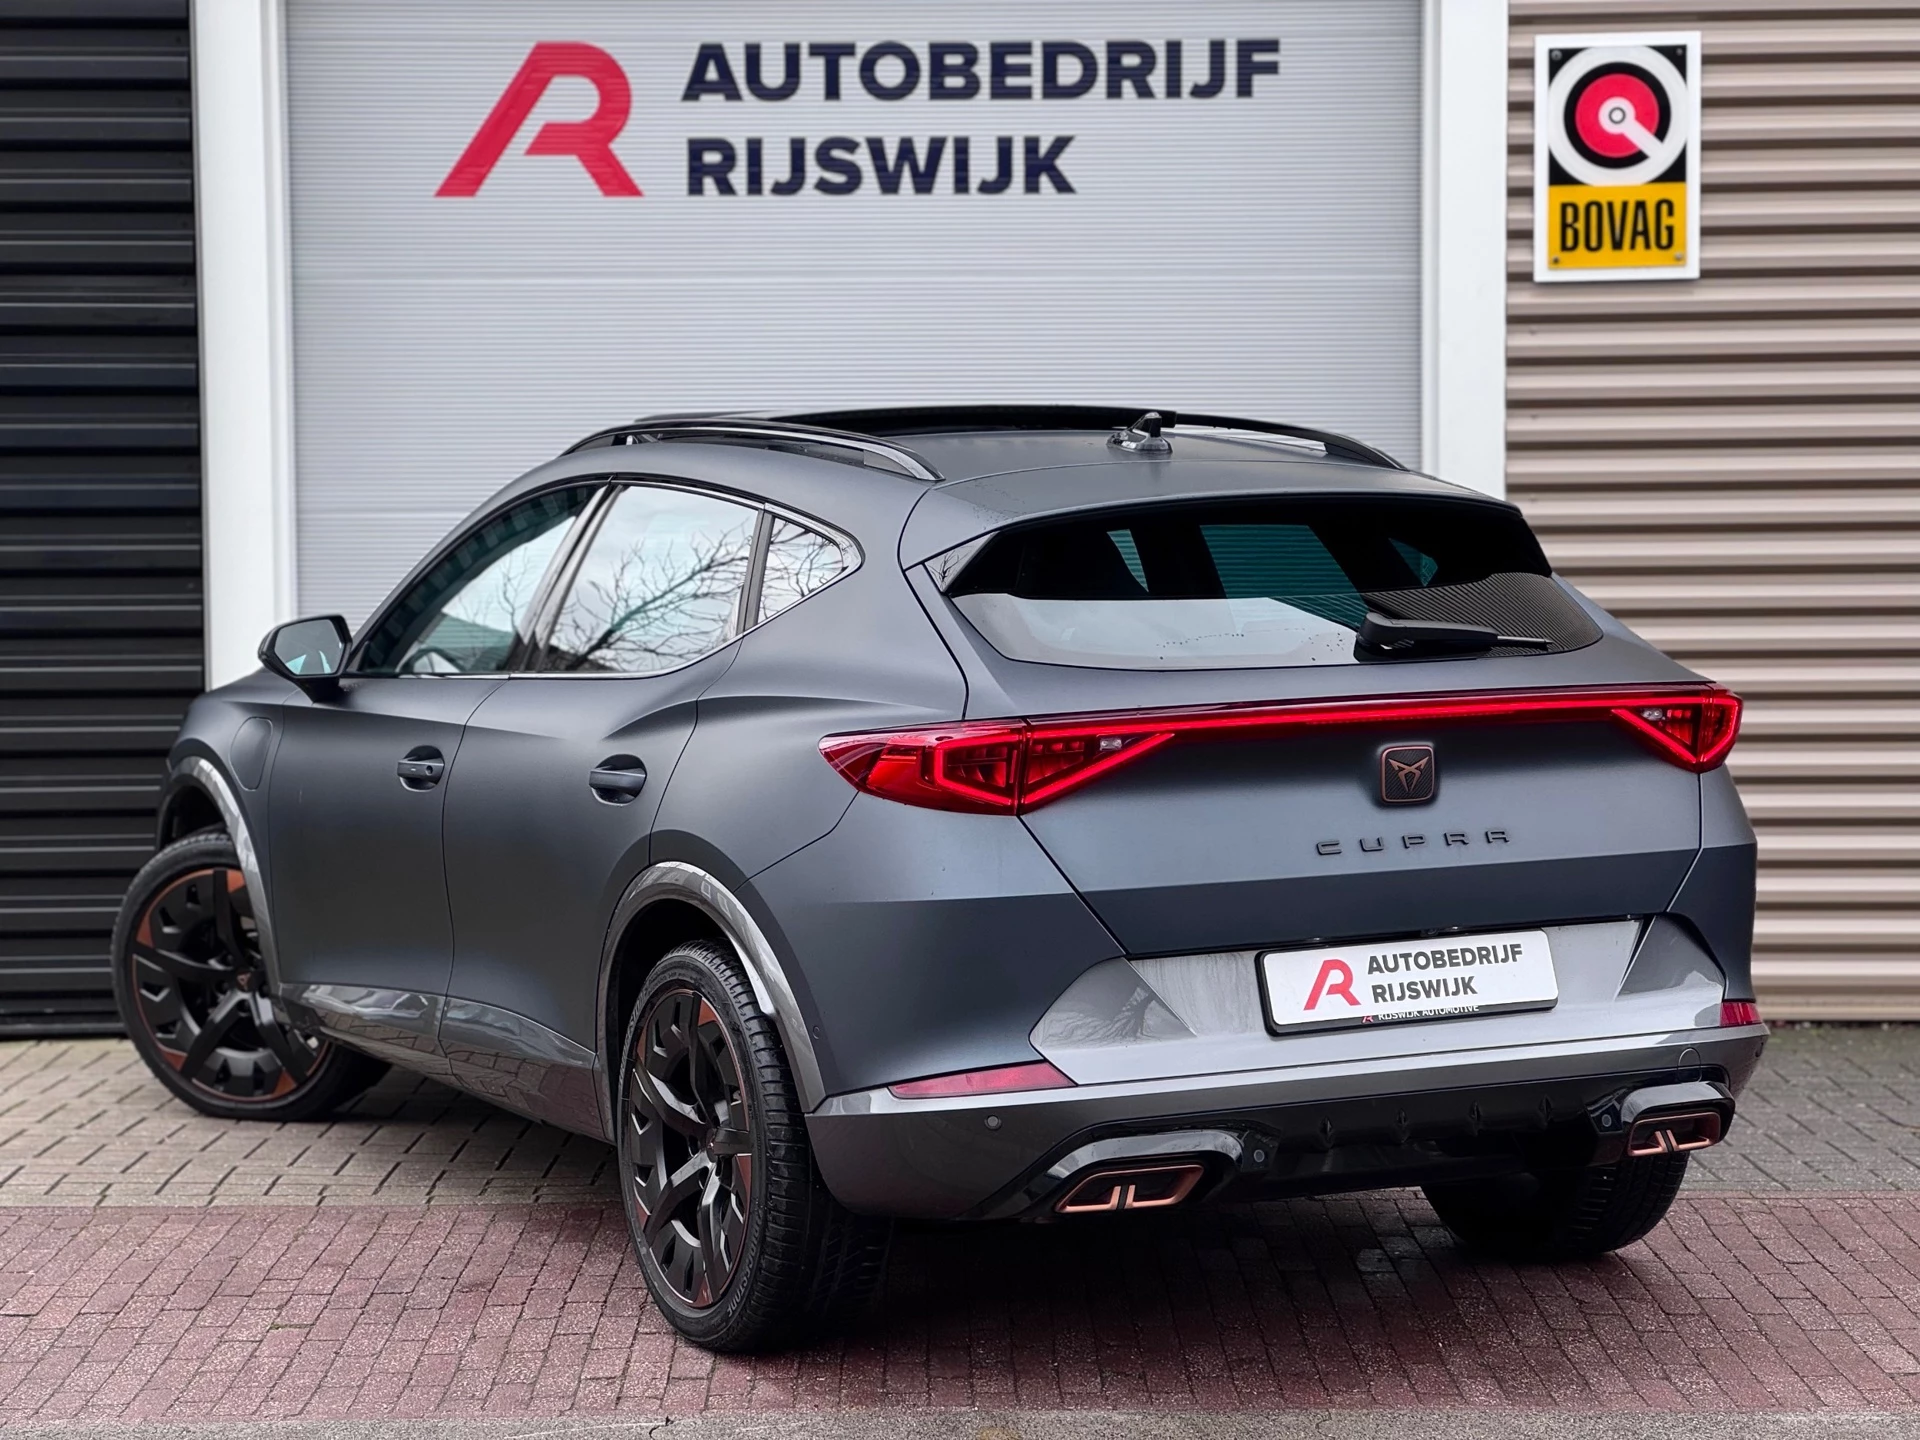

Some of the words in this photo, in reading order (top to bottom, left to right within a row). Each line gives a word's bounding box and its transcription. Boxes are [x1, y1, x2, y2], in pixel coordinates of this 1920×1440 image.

[682, 39, 1280, 102] AUTOBEDRIJF
[687, 136, 1076, 196] RIJSWIJK
[1560, 199, 1675, 252] BOVAG
[1316, 829, 1510, 856] CUPRA
[1367, 943, 1523, 975] AUTOBEDRIJF
[1371, 976, 1478, 1004] RIJSWIJK
